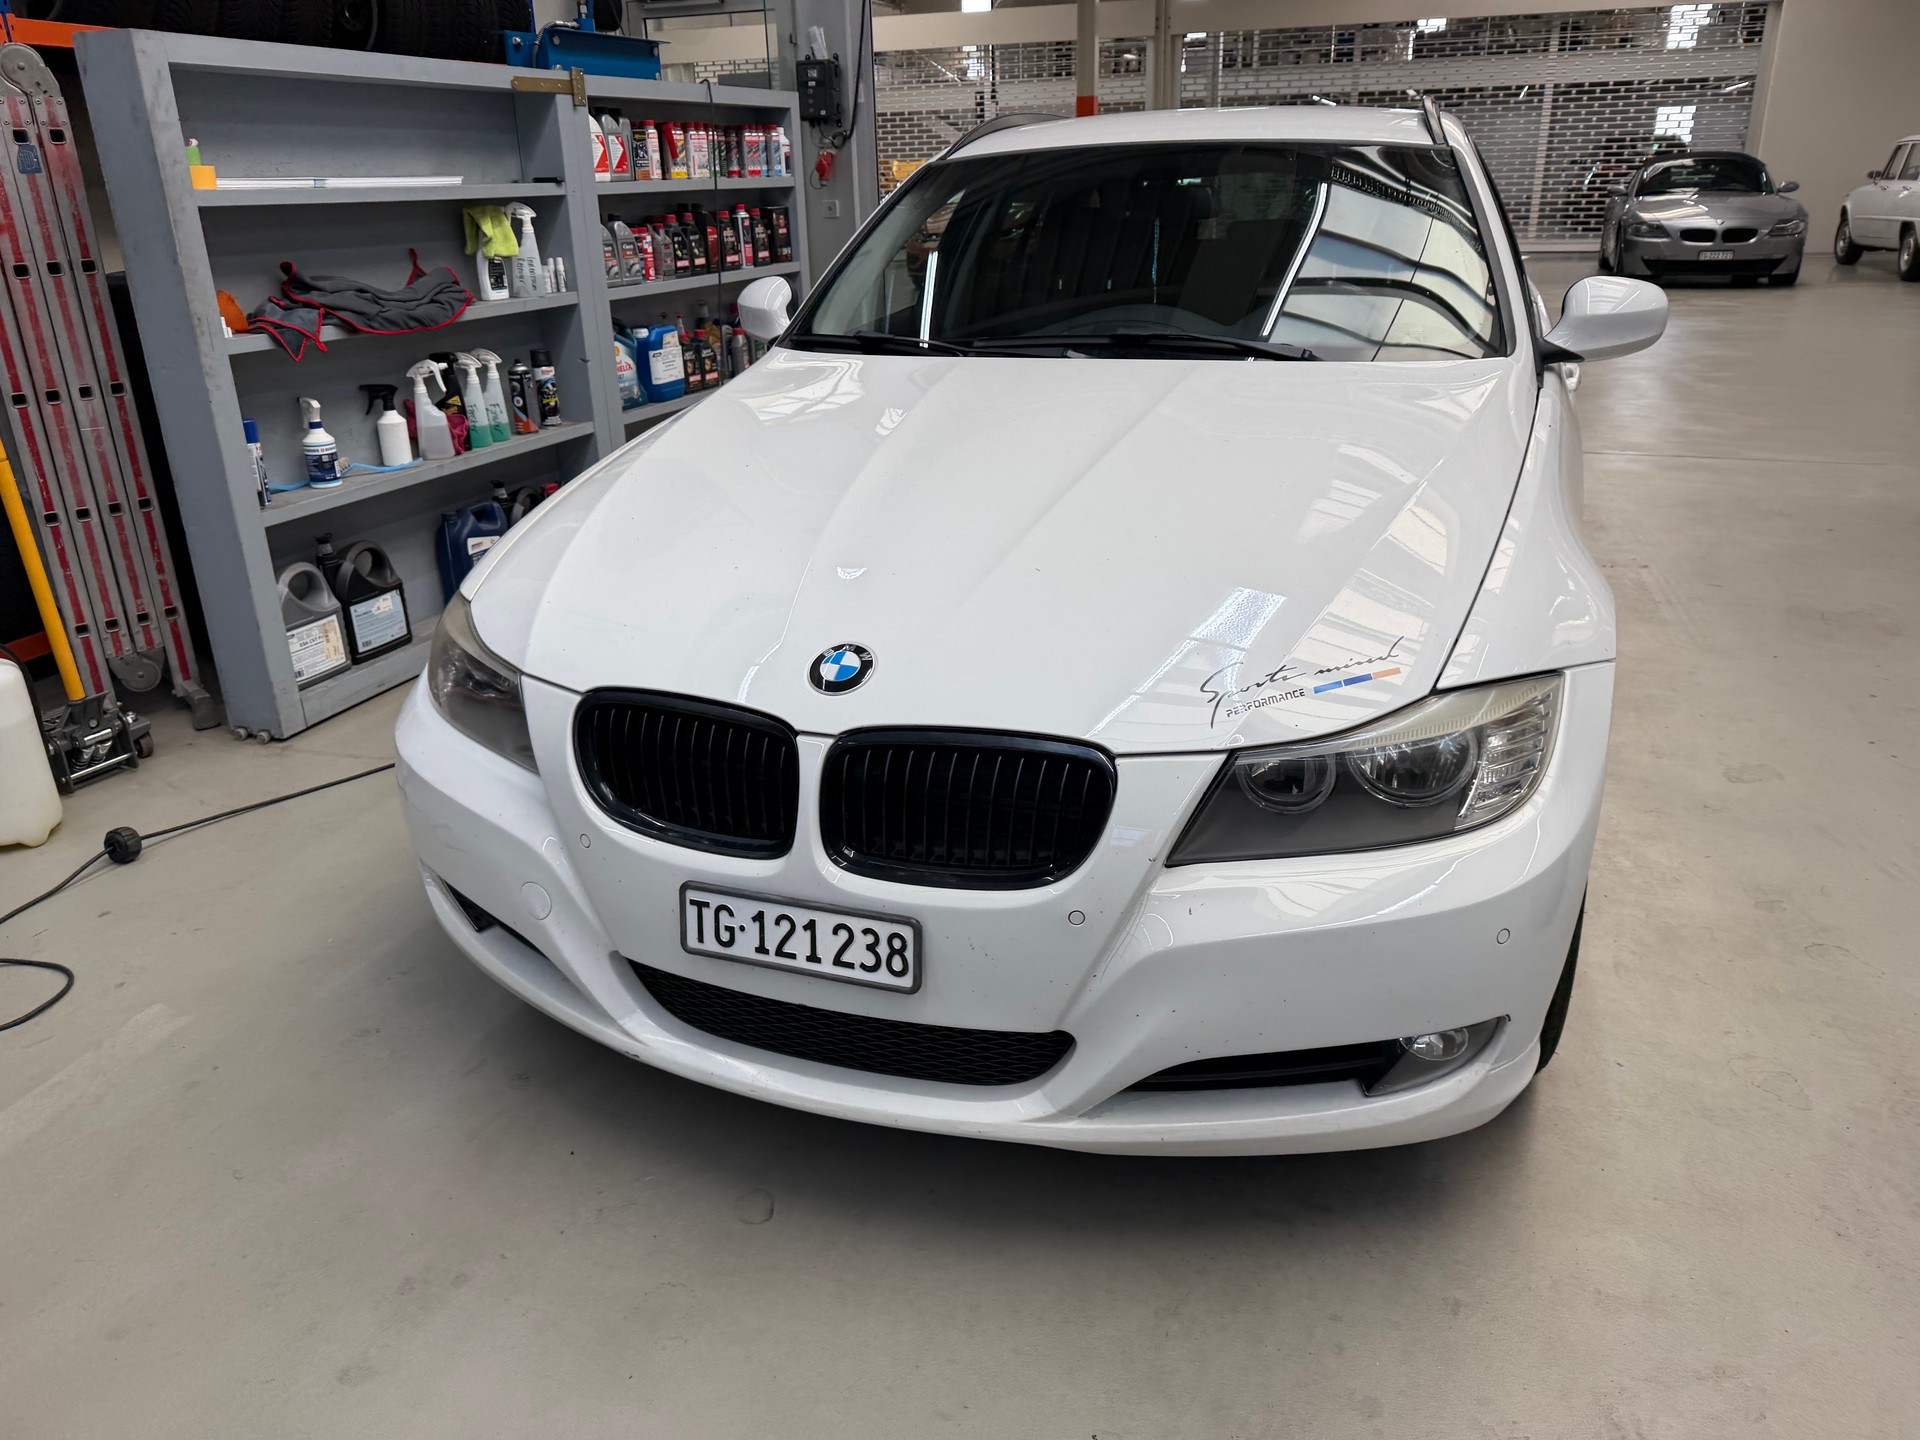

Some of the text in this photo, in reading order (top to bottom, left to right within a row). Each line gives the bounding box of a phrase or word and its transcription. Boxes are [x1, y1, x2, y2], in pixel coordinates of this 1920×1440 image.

[822, 644, 873, 662] BMW
[1199, 661, 1307, 730] Sports
[1225, 688, 1306, 718] PERFORMANCE
